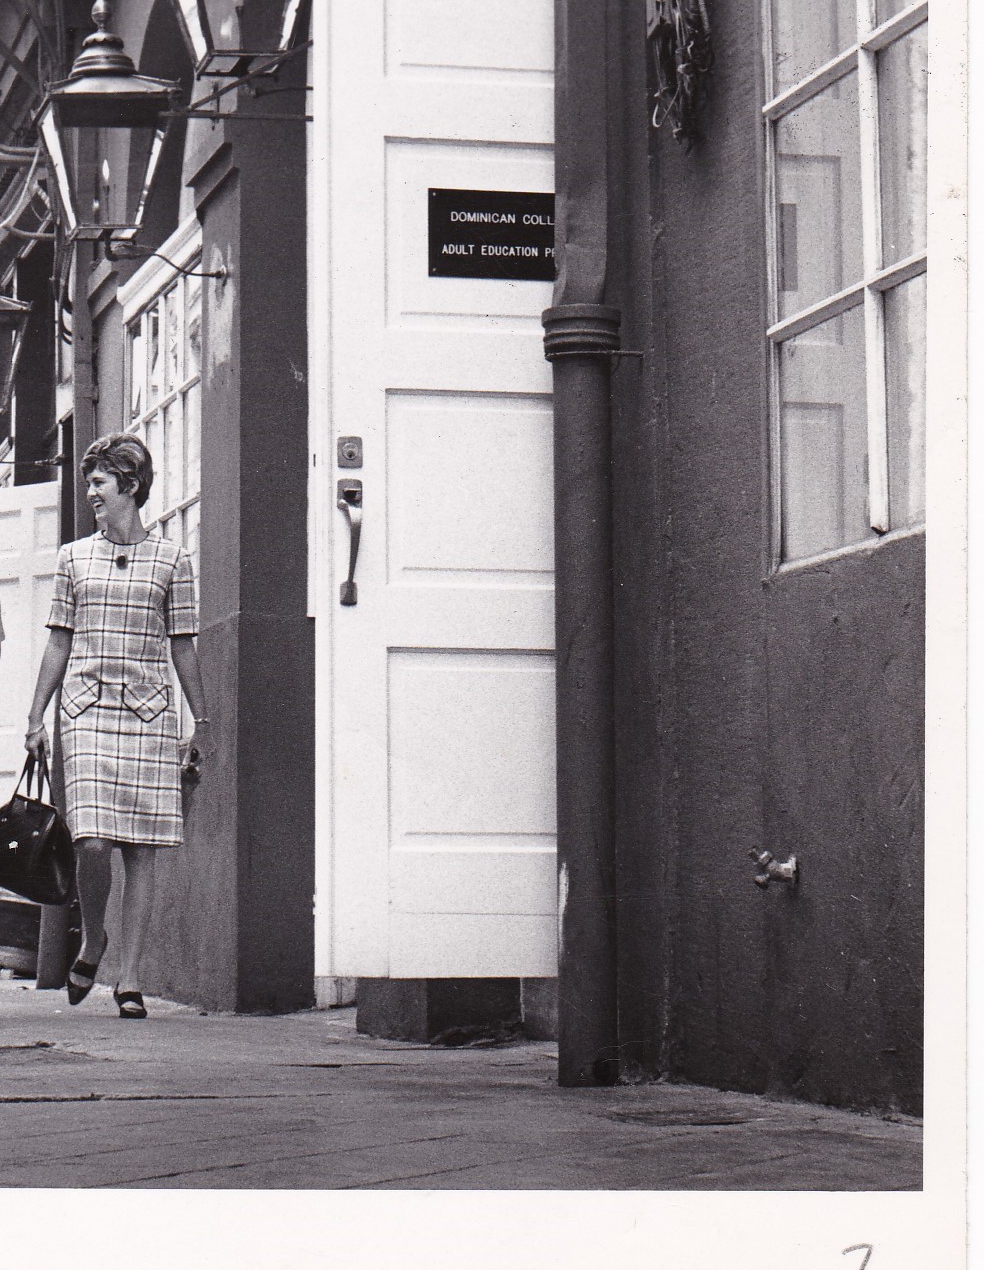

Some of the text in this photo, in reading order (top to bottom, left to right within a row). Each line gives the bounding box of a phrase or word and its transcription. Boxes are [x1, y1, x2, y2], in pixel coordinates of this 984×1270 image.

[450, 211, 516, 224] DOMINICAN
[442, 244, 475, 255] ADULT
[481, 244, 539, 257] EDUCATION
